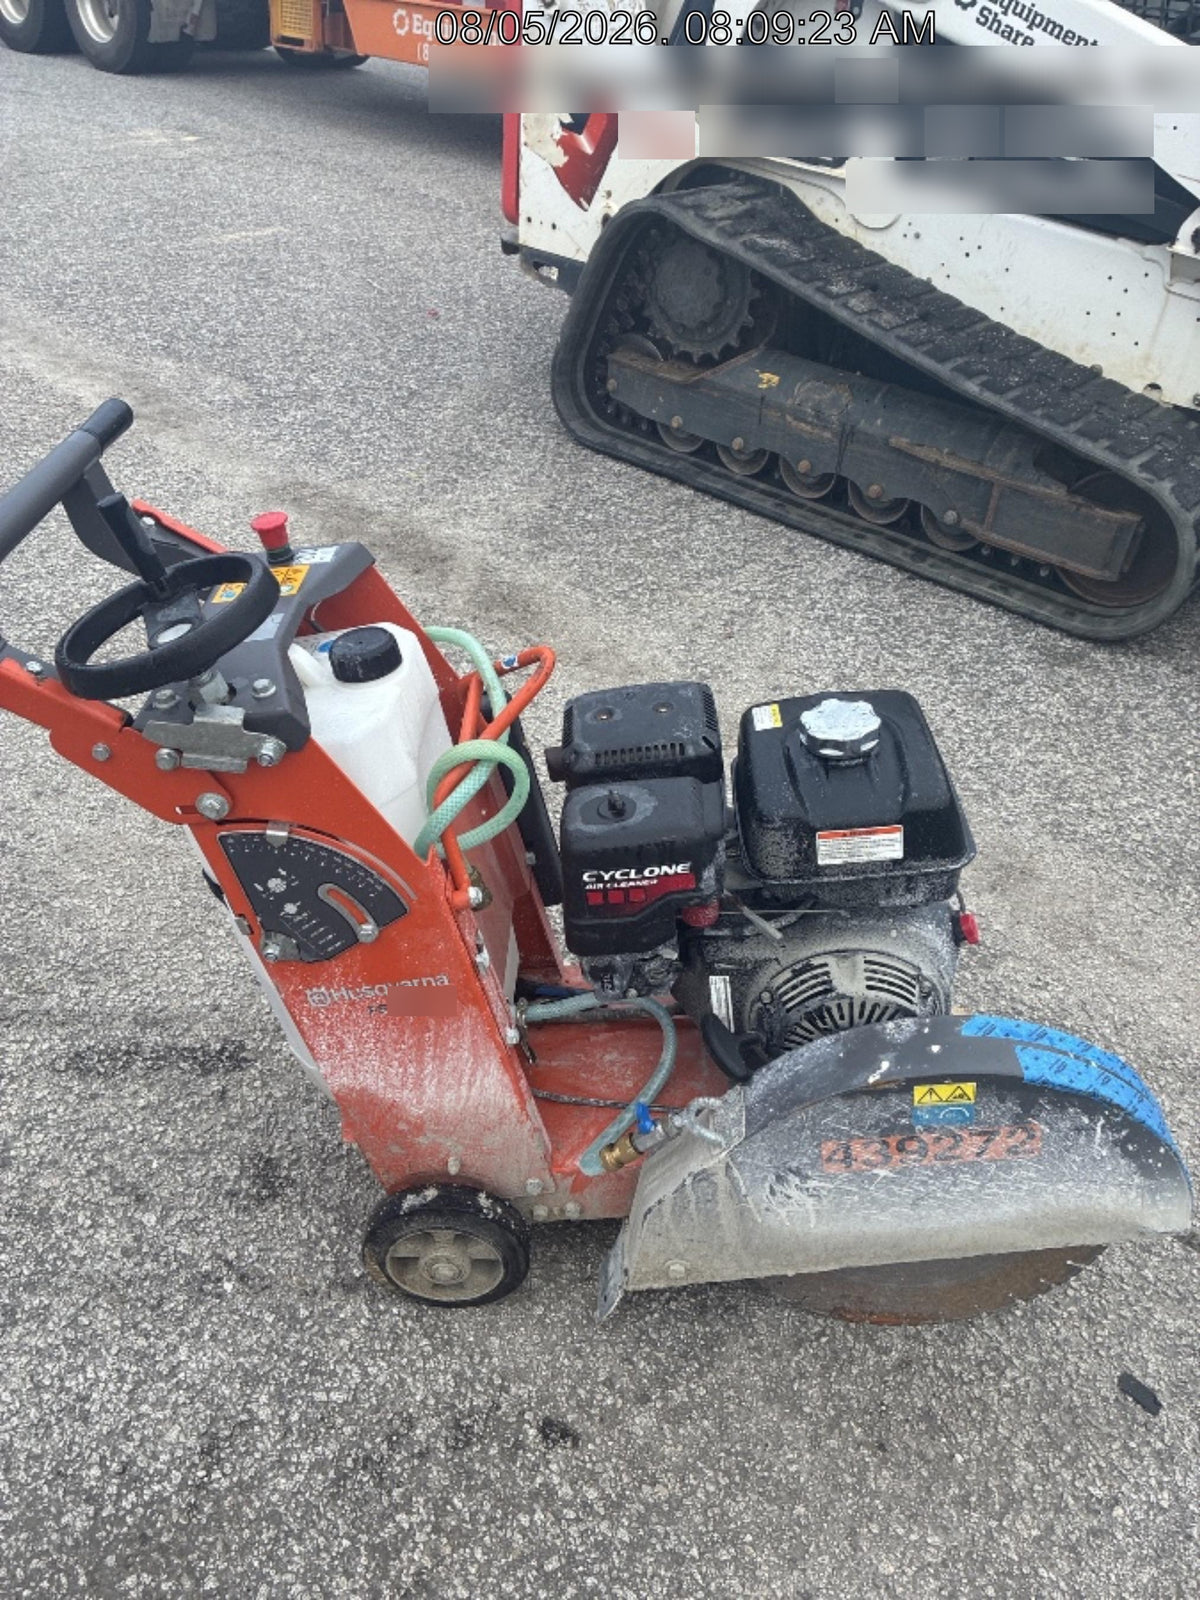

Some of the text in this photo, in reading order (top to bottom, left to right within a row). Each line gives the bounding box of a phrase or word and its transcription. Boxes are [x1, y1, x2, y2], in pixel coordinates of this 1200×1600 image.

[976, 5, 1035, 46] Share
[582, 862, 692, 882] CYCLONE
[606, 880, 658, 888] CLEANER
[332, 974, 449, 1002] Husqarna
